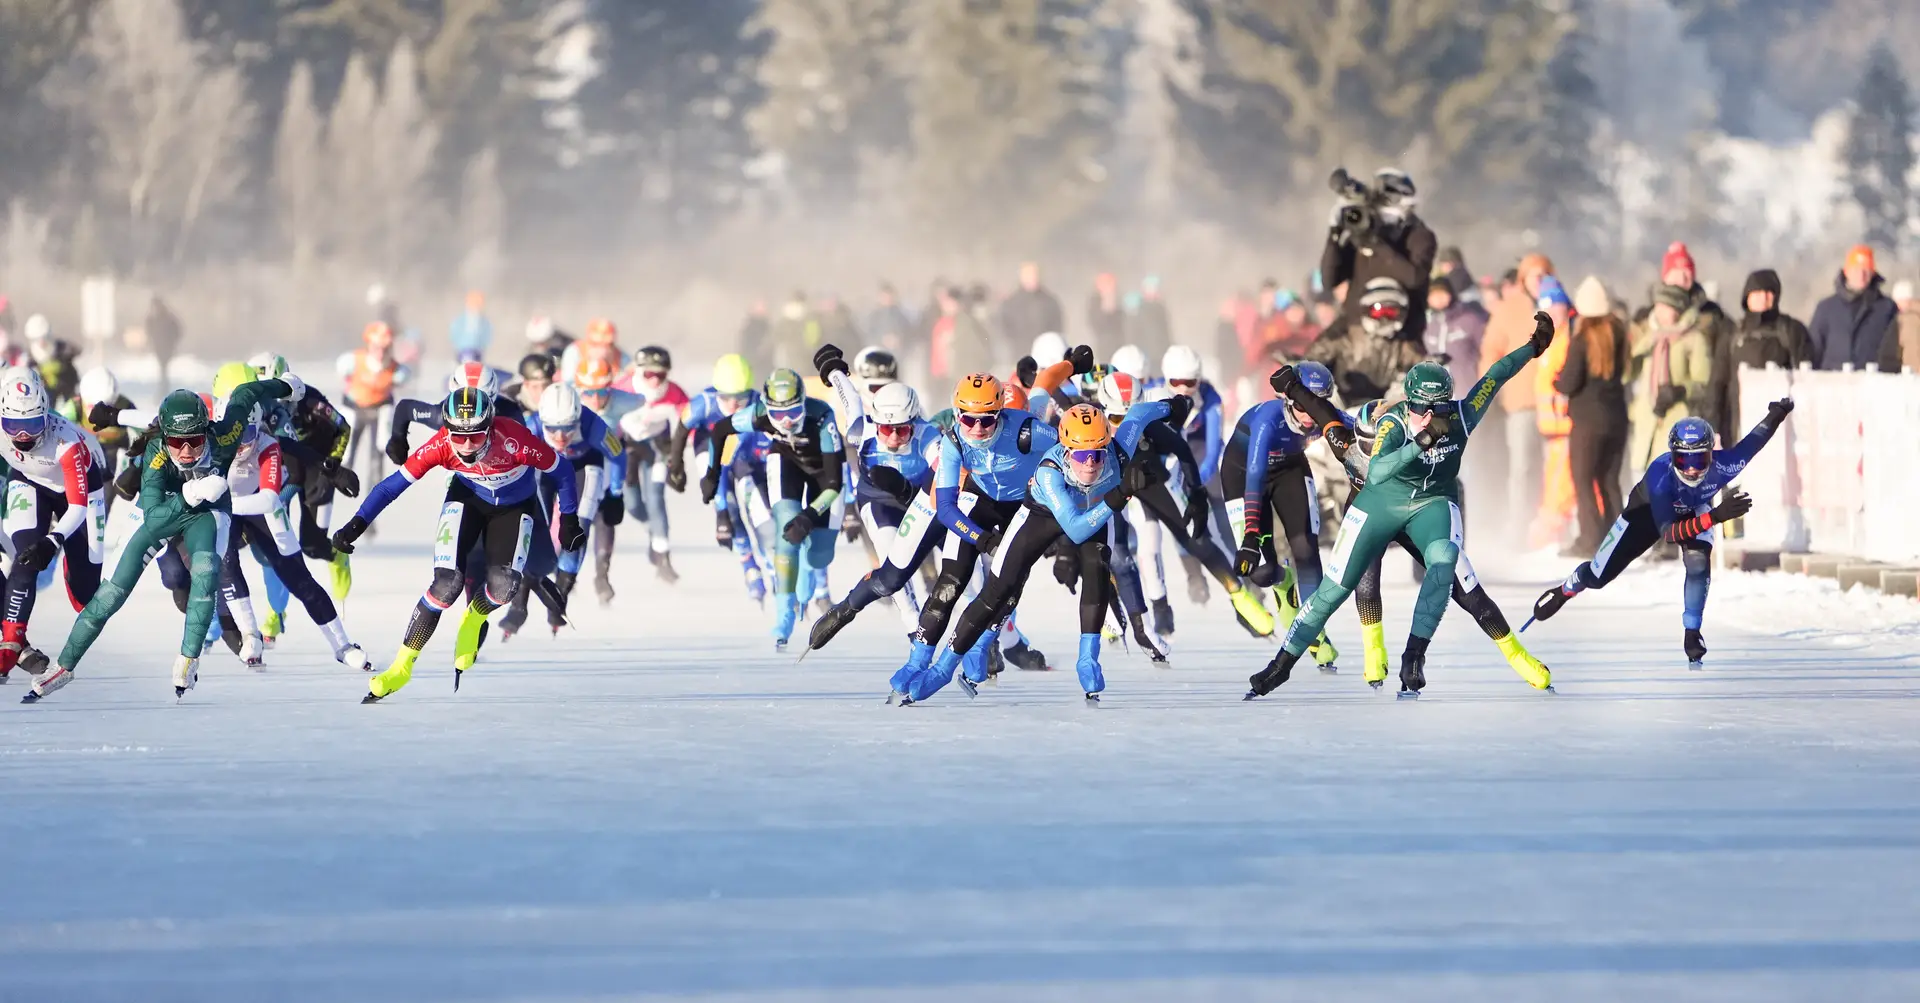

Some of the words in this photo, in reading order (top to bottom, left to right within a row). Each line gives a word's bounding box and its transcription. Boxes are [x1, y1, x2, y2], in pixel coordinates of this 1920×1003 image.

[1469, 377, 1496, 413] xenos
[72, 448, 87, 497] Turner
[268, 447, 280, 485] Turner
[10, 493, 32, 511] 4
[273, 508, 290, 532] 7
[898, 514, 916, 538] 6
[437, 521, 453, 545] 4
[1600, 531, 1615, 552] 7
